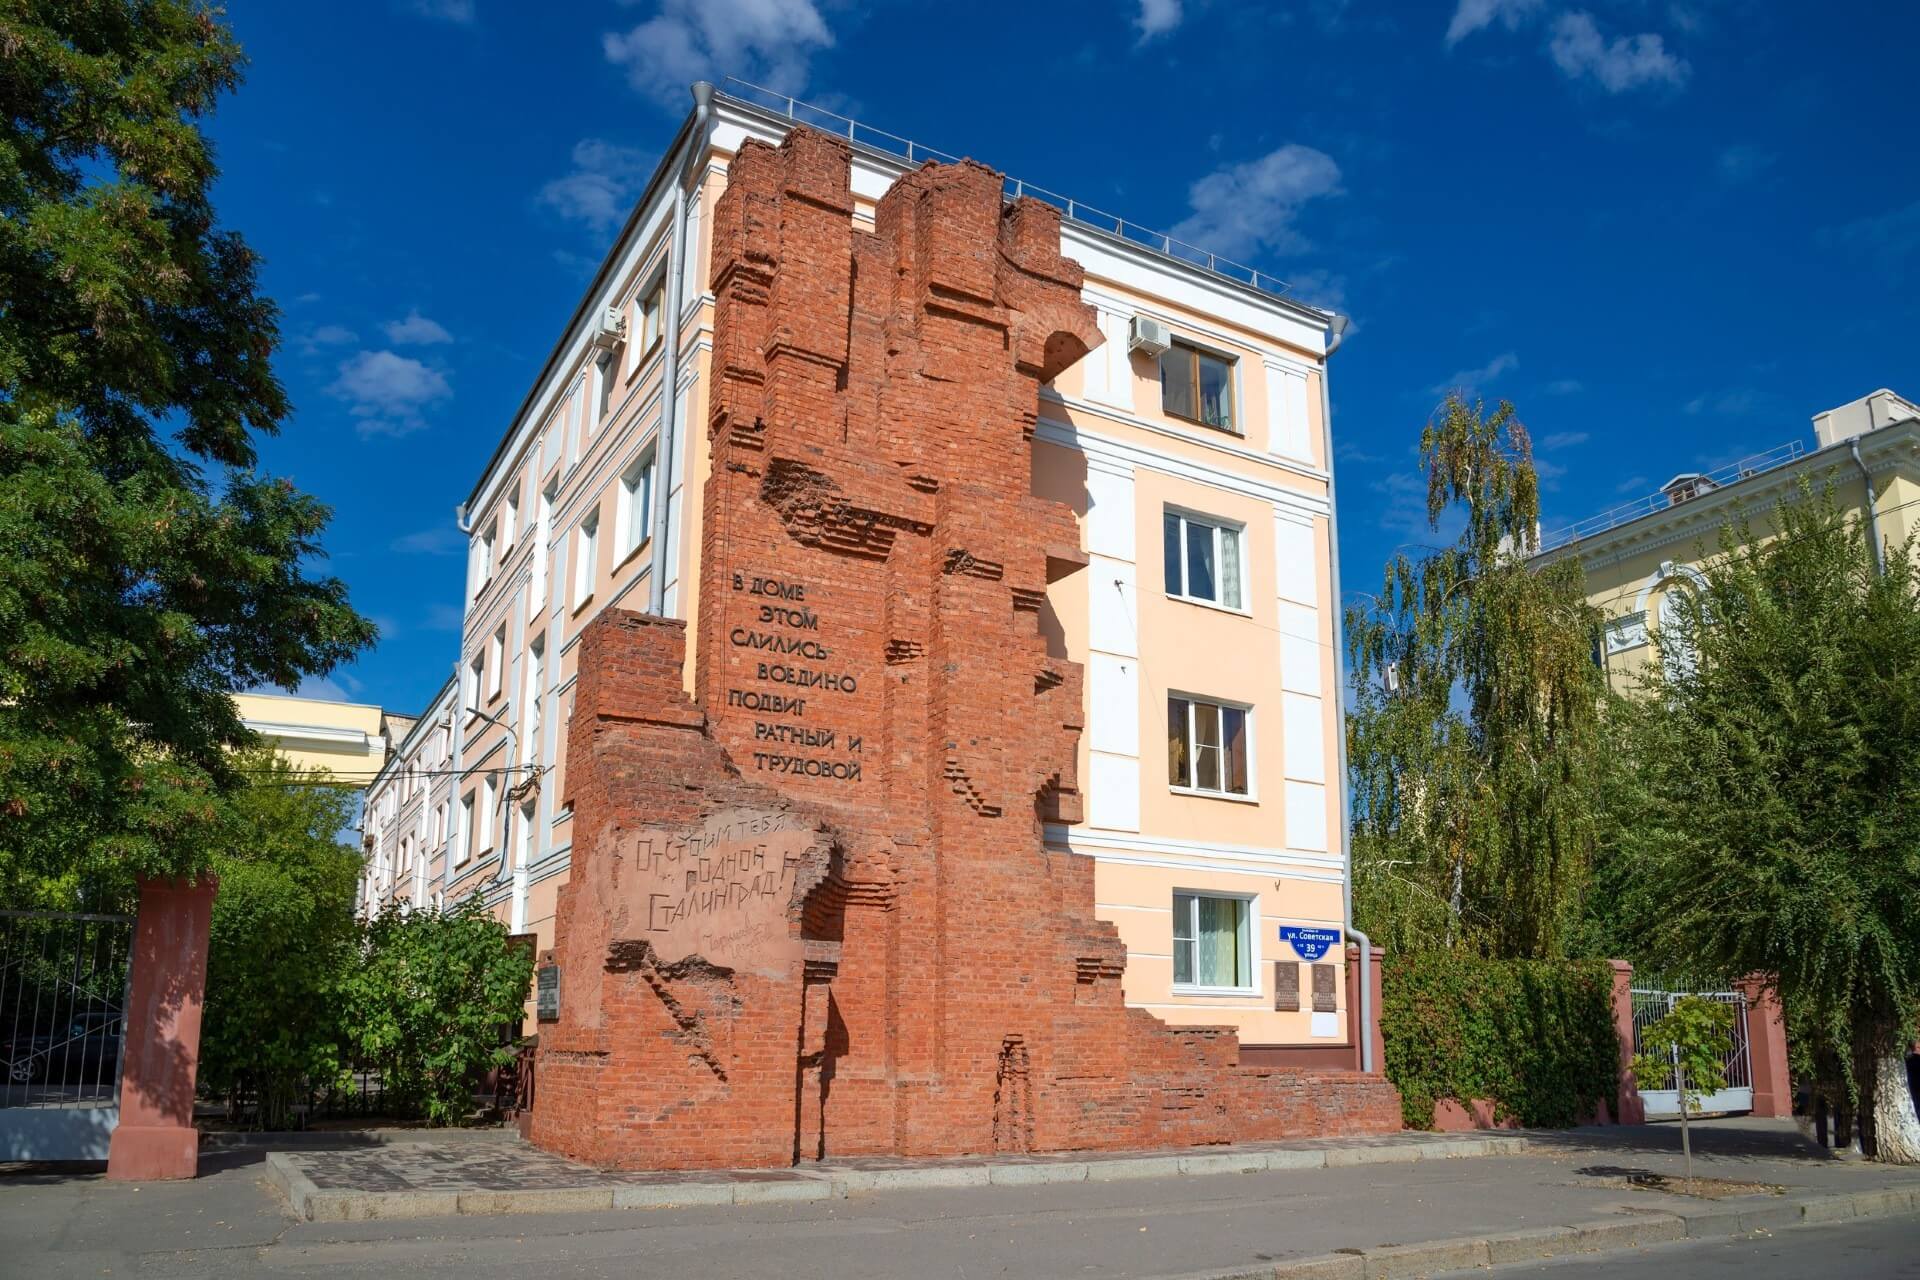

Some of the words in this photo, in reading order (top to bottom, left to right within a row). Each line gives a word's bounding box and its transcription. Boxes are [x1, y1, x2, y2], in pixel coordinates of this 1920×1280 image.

[733, 573, 743, 591] В
[750, 577, 805, 601] ДОМЕ
[759, 605, 818, 631] ЭТОМ
[730, 629, 828, 660] СЛИЛИСЬ
[757, 663, 857, 693] ВОЕДИНО
[728, 688, 806, 716] ПОДВИГ
[755, 721, 835, 749] РАТНЫЙ
[848, 736, 862, 753] И
[753, 752, 861, 782] ТРУДОВОЙ
[737, 813, 786, 841] ТЕБЯ
[1299, 932, 1334, 941] Советская
[1306, 944, 1315, 952] 39
